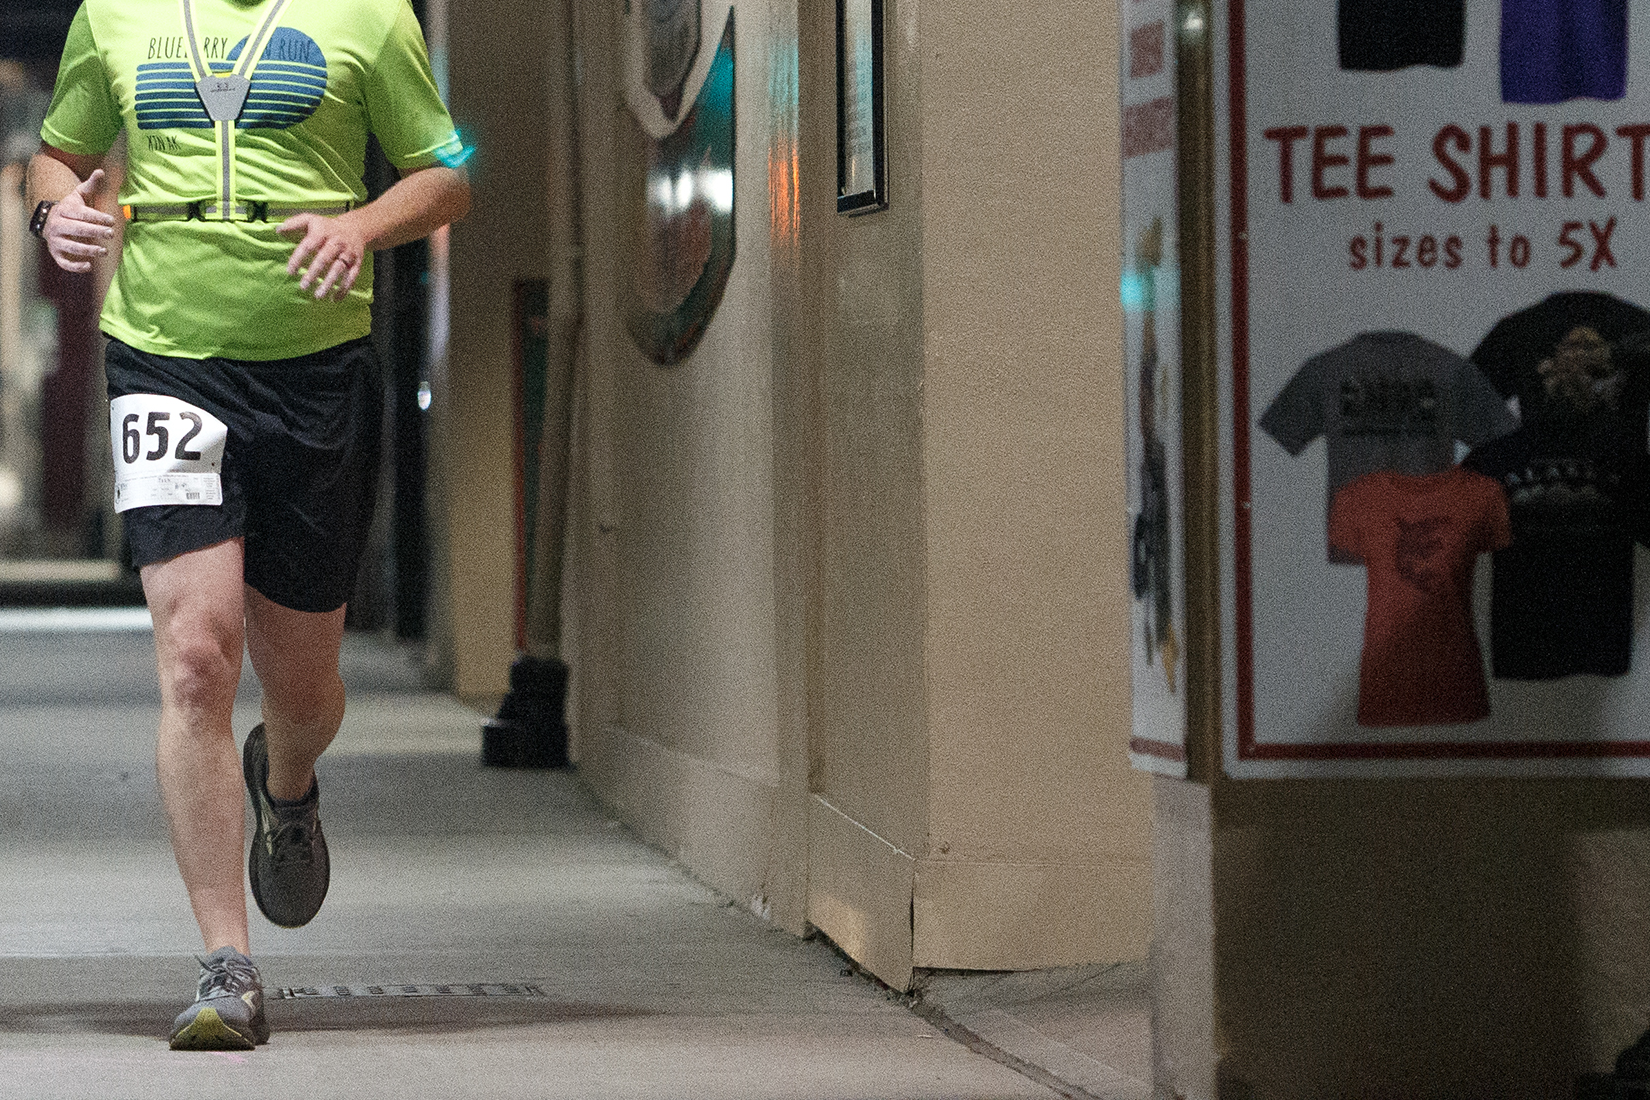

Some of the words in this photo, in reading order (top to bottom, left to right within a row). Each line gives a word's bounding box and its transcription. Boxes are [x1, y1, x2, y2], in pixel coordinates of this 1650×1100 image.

[147, 36, 229, 60] BLUERRY
[278, 39, 311, 62] RUN
[166, 135, 182, 151] AK
[1264, 124, 1395, 203] TEE
[1428, 121, 1650, 204] SHIRT
[1350, 220, 1463, 270] sizes
[1488, 225, 1532, 269] to
[1558, 217, 1618, 272] 5X
[122, 411, 203, 465] 652
